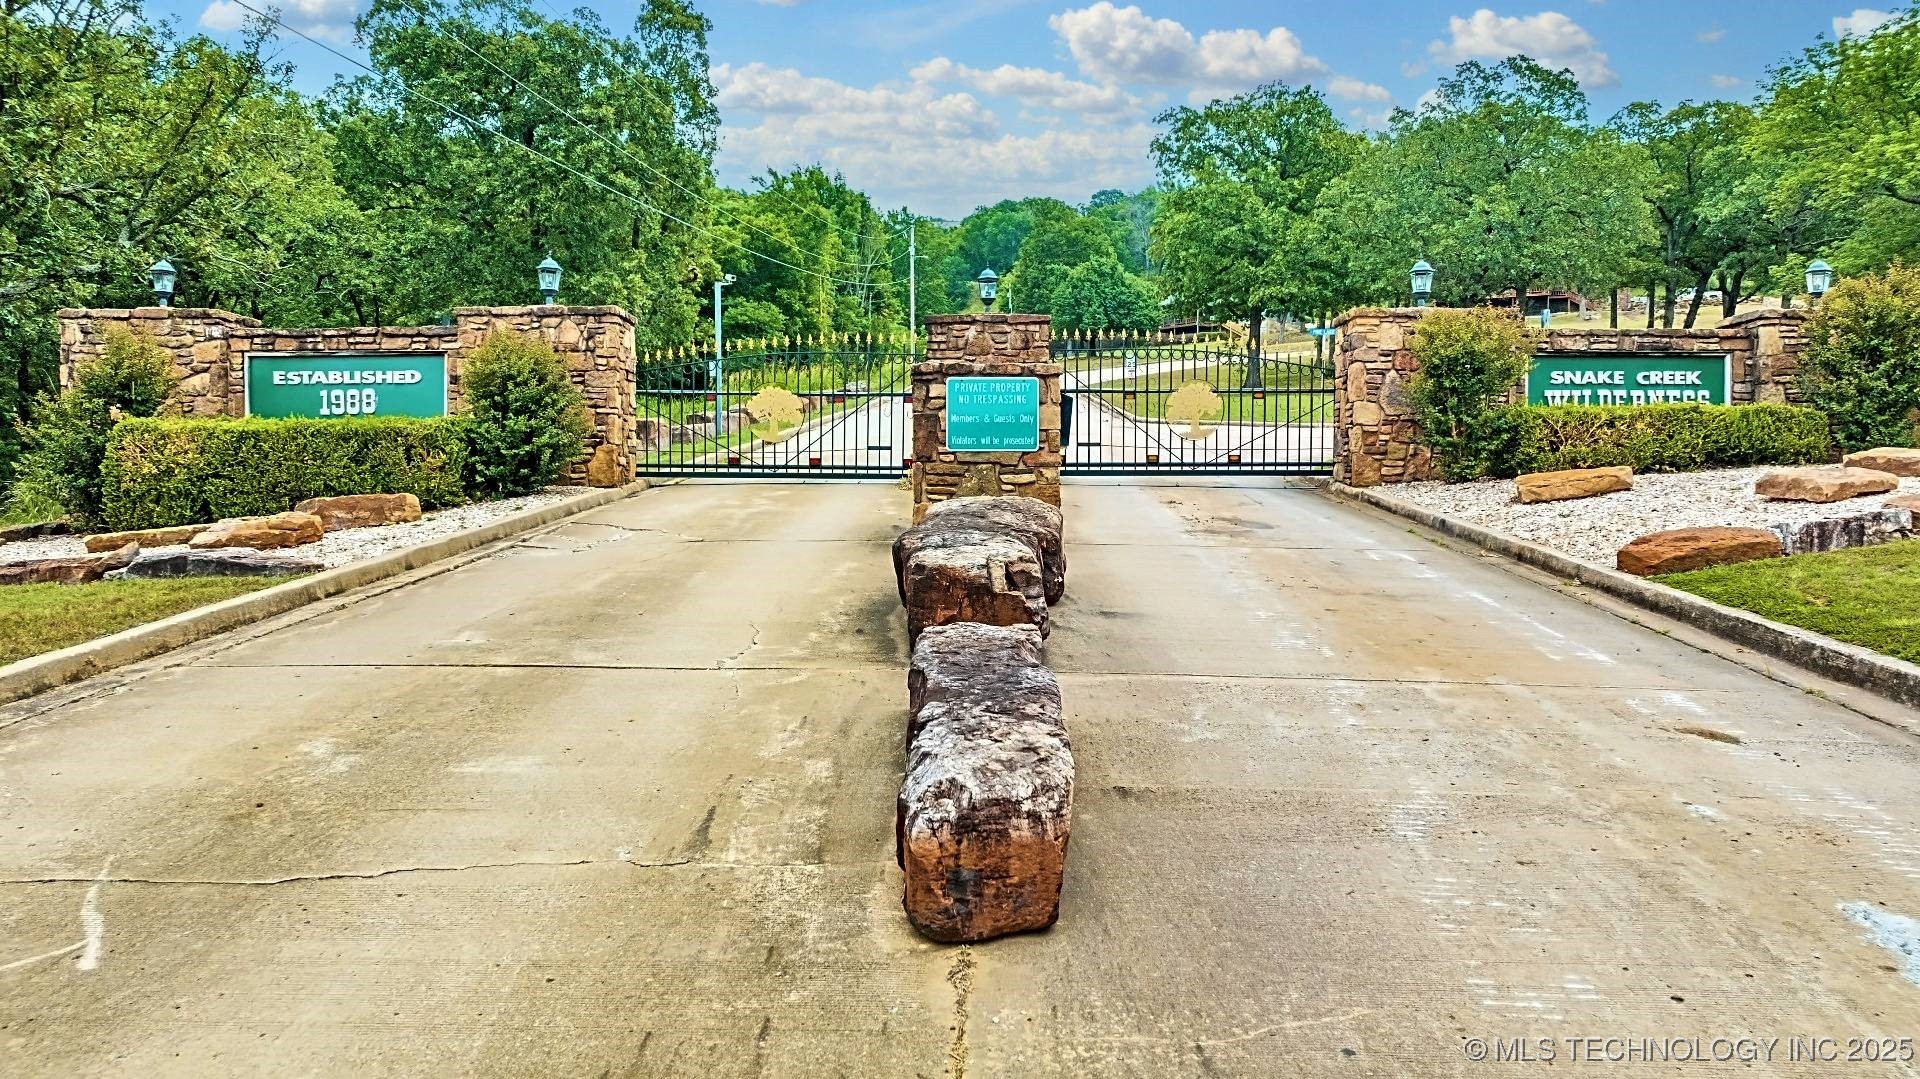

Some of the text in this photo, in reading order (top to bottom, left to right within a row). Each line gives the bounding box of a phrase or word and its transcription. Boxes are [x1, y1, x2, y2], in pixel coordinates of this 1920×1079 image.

[272, 370, 422, 385] ESTABLISHED
[1549, 370, 1703, 385] SNAKE CREEK
[955, 383, 1030, 392] PRIVATE PROPERTY
[319, 388, 378, 416] 1988
[958, 395, 1027, 404] NO TRESPASSING
[951, 414, 1034, 424] Members & Guests Only
[951, 436, 1034, 446] Violators will be prosecuted
